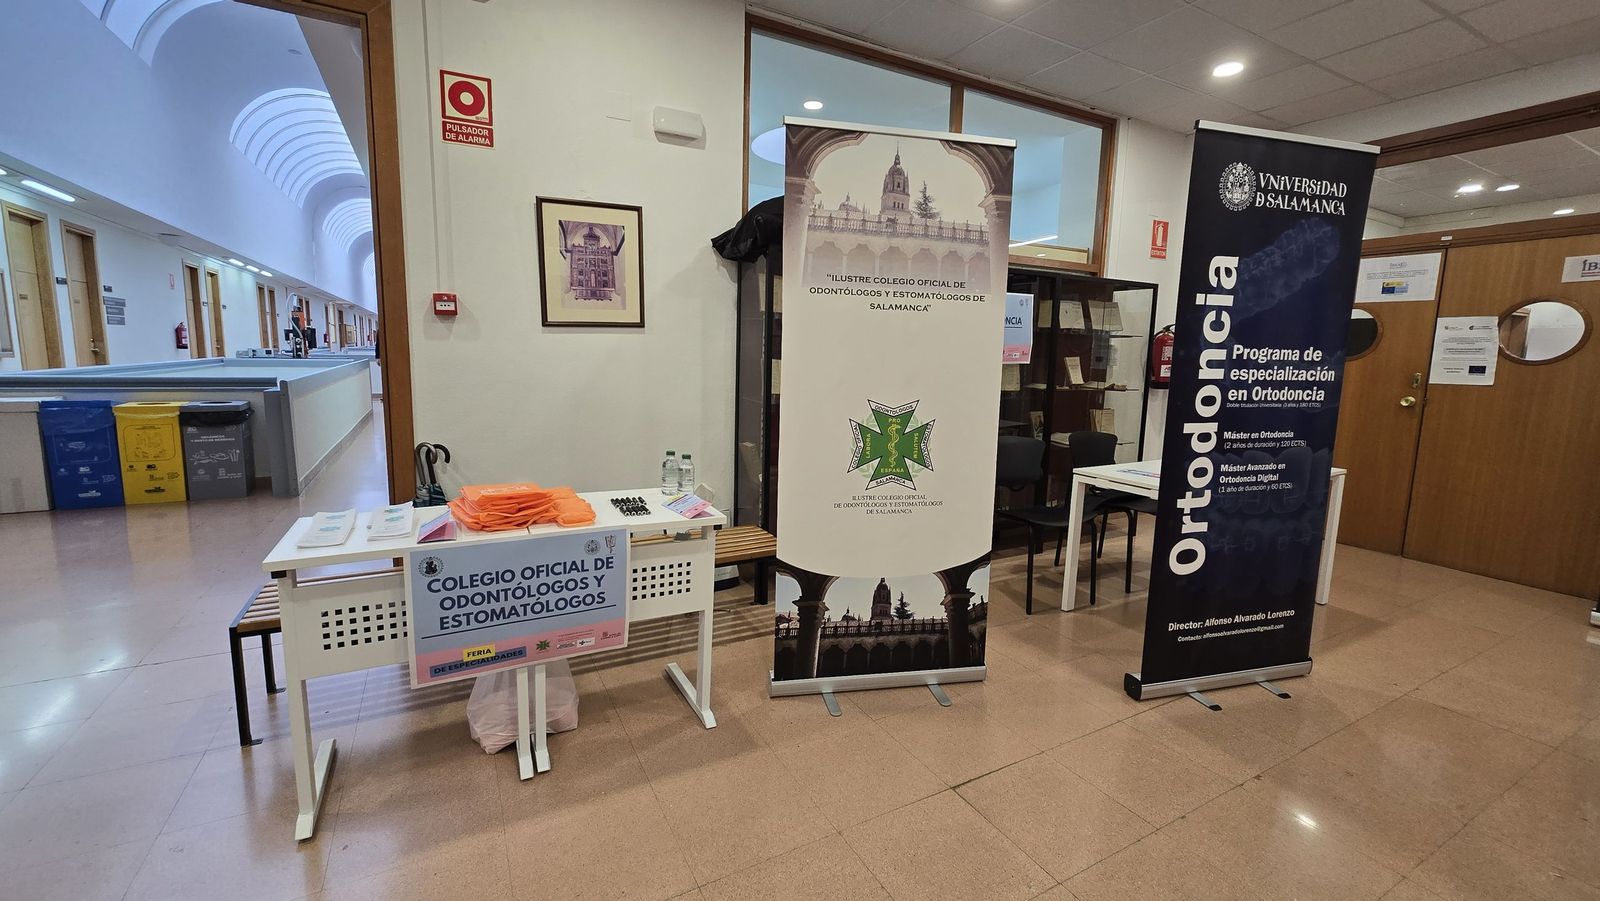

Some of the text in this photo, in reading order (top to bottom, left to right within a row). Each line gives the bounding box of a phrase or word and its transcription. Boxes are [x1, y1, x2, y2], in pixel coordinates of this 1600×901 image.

[446, 123, 489, 136] PULSADOR
[446, 132, 491, 145] DE ALARMA
[1267, 192, 1346, 216] SALAMANCA
[873, 276, 915, 286] COLEGIO
[917, 279, 952, 288] OFICIAL
[810, 286, 882, 298] ODONTÓLOGOS
[892, 291, 971, 302] ESTOMATÓLOGOS
[1005, 316, 1022, 326] NCIA
[1232, 344, 1322, 364] Programa de
[1230, 366, 1336, 384] especialización
[1228, 386, 1325, 401] en Ortodoncia
[1168, 254, 1240, 576] Ortodoncia
[1223, 430, 1250, 439] Máster
[1260, 430, 1294, 438] Ortodoncia
[1224, 442, 1232, 450] (2
[1220, 464, 1246, 472] Máster
[1246, 463, 1276, 471] Avanzado
[1220, 474, 1279, 484] Ortodoncia Digital
[426, 556, 614, 594] COLEGIO OFICIAL DE
[439, 574, 606, 611] ODONTÓLOGOS Y
[439, 591, 606, 631] ESTOMATÓLOGOS
[1168, 609, 1295, 632] Director: Alfonso Alvarado Lorenzo
[466, 648, 492, 658] FERIA
[434, 666, 446, 674] DE
